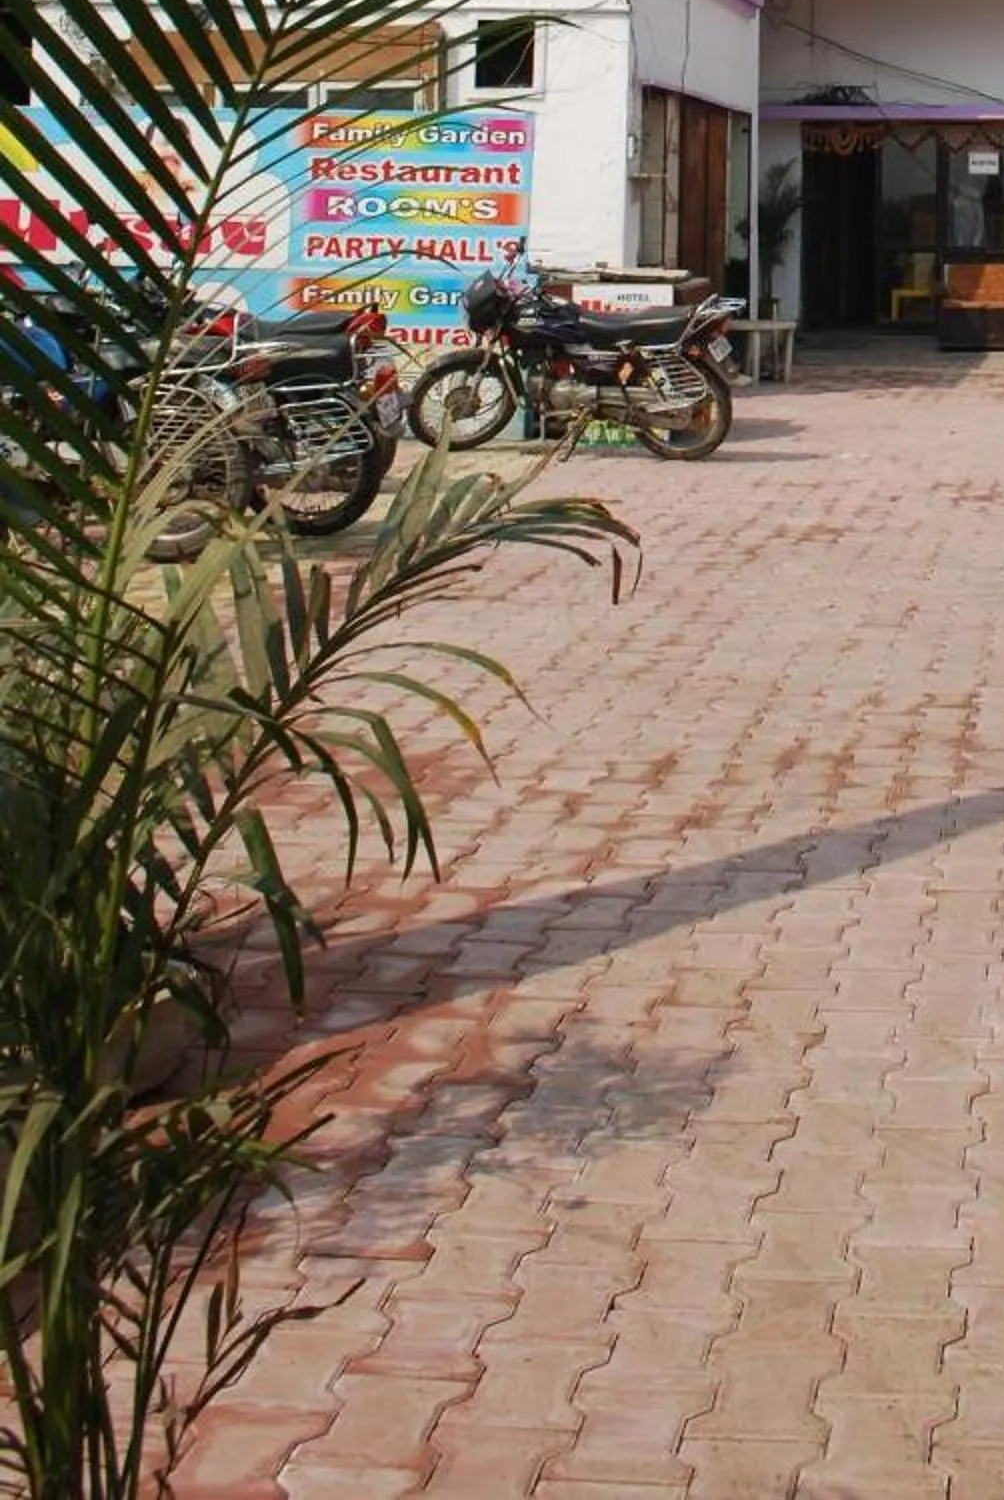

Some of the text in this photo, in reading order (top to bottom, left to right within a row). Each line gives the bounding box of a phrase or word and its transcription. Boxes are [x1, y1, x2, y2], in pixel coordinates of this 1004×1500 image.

[419, 128, 526, 146] Garden
[311, 157, 521, 185] Restaurant
[327, 196, 499, 220] ROOM'S
[307, 236, 403, 260] PARTY
[303, 285, 464, 309] Family Gar
